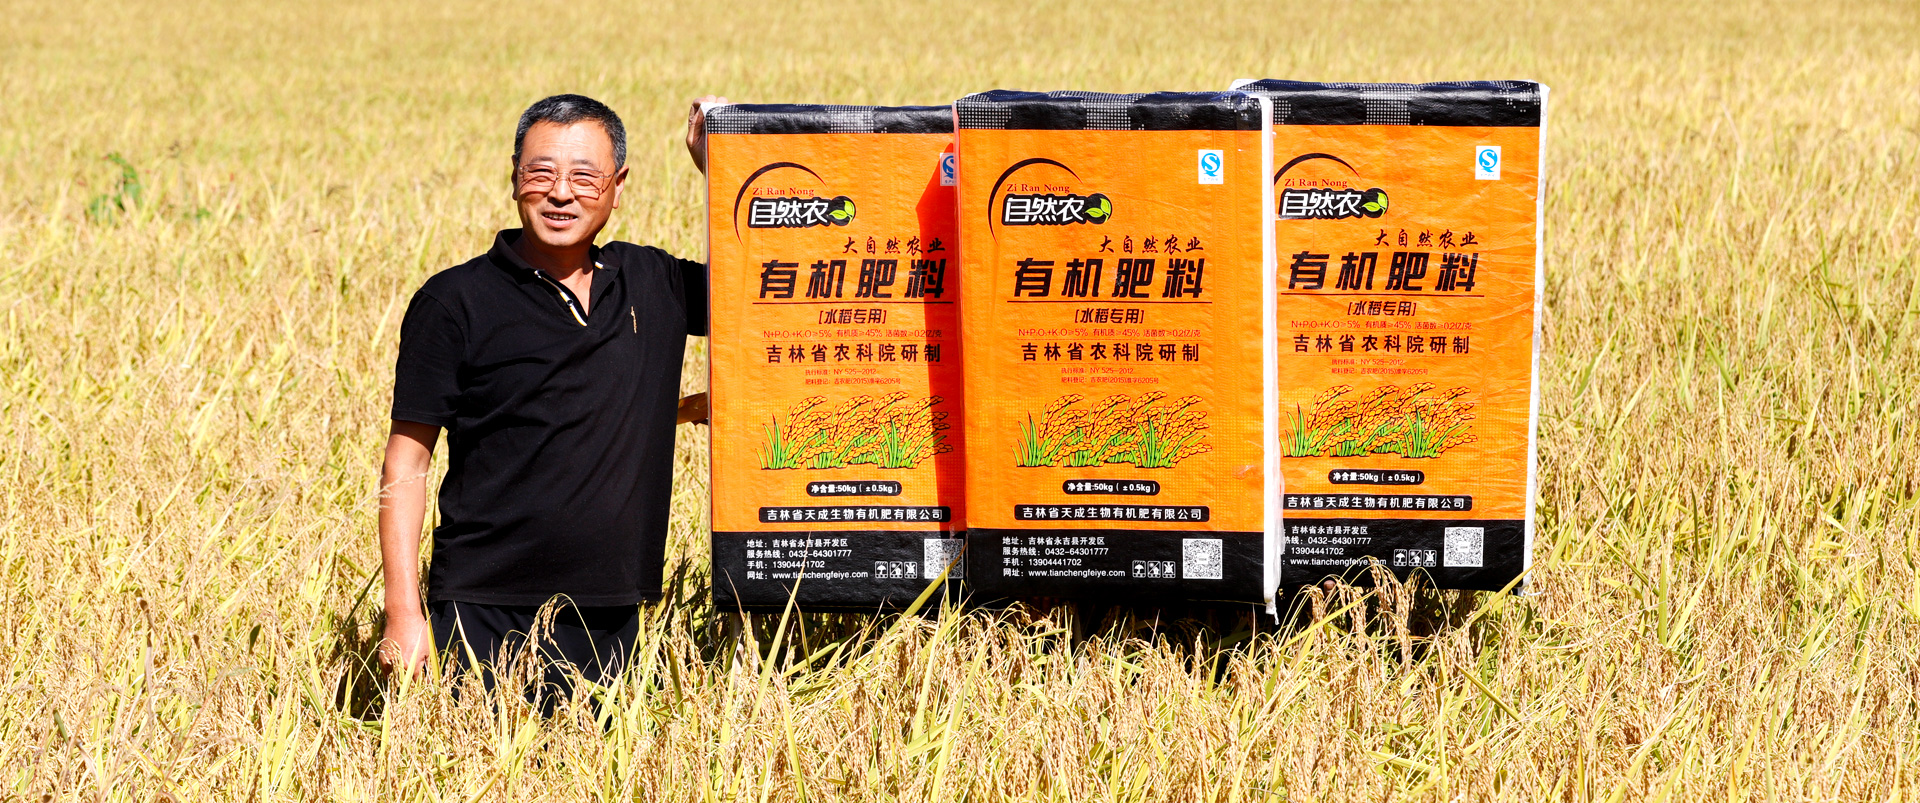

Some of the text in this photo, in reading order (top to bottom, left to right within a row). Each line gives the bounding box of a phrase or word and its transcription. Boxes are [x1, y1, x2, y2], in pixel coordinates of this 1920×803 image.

[752, 188, 814, 197] Zi Ran Nong
[1006, 184, 1070, 193] Zi Ran Nong
[1285, 178, 1294, 186] Zi
[1322, 179, 1348, 188] Nong
[751, 201, 828, 226] 自然农
[1004, 197, 1084, 222] 自然农
[1282, 192, 1361, 216] 自然农
[843, 236, 946, 256] 大自然农业
[1099, 235, 1204, 255] 大自然农业
[1374, 229, 1478, 249] 大自然农业
[759, 258, 946, 298] 有机肥料
[1014, 258, 1204, 298] 有机肥料
[1288, 251, 1478, 291] 有机肥料
[766, 344, 941, 363] 吉林省农科院研制
[1022, 343, 1199, 362] 吉林省农科院研制
[1294, 334, 1469, 354] 吉林省农科院研制
[1288, 497, 1464, 508] 吉林省天成生物有机肥有限公司
[767, 509, 942, 520] 吉林省天成生物有机肥有限公司
[1023, 507, 1202, 520] 吉林省天成生物有机肥有限公司
